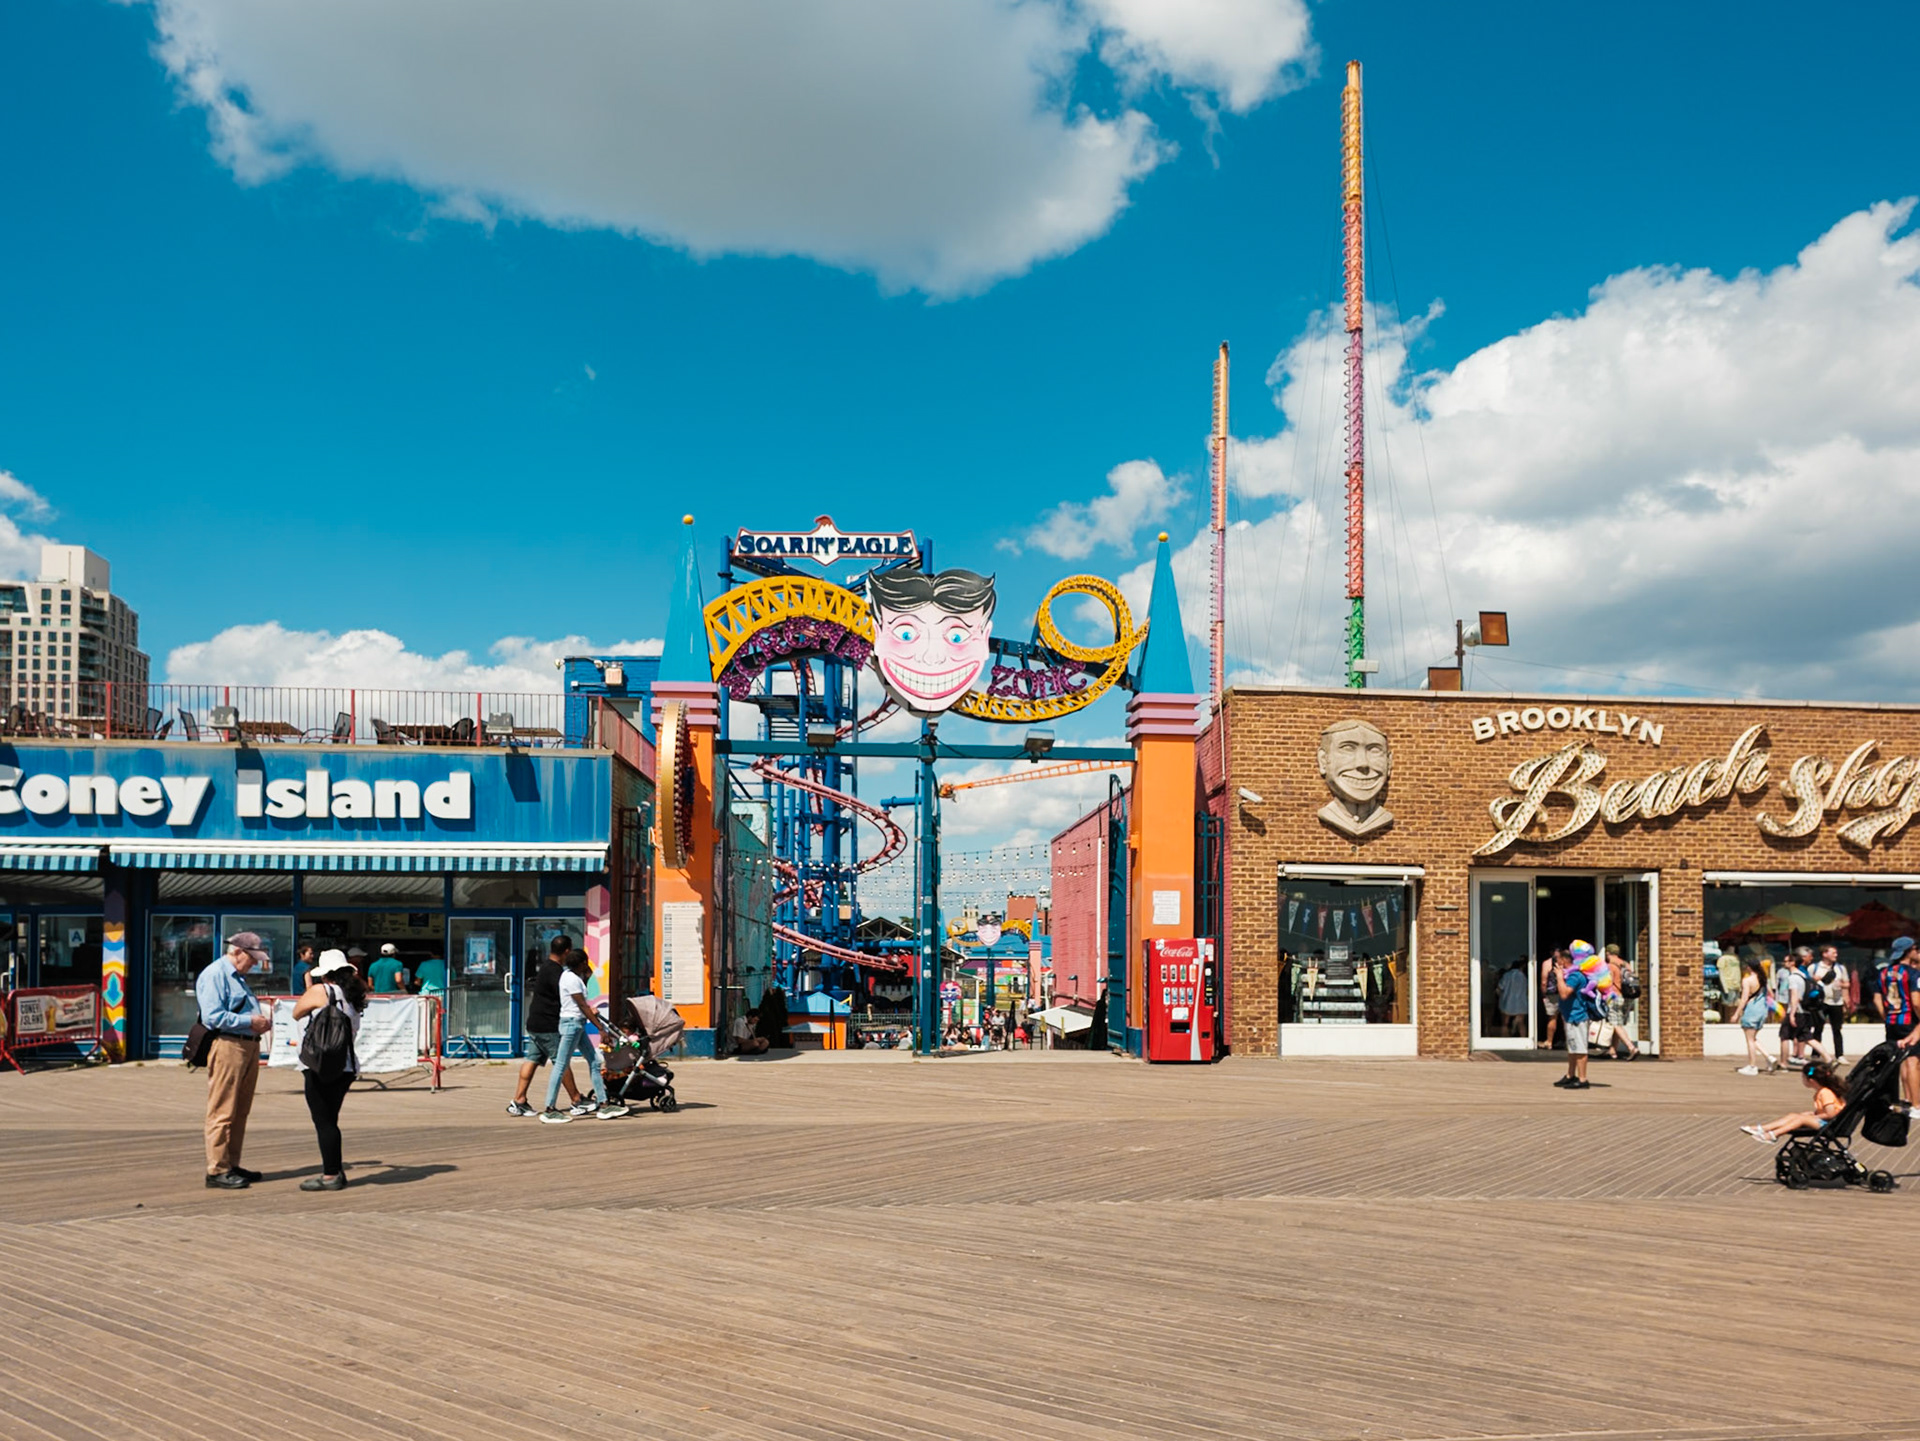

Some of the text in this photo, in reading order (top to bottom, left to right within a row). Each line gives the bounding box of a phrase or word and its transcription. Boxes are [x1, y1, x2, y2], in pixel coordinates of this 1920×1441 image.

[739, 535, 913, 556] SOARIN' EAGLE
[1472, 707, 1664, 746] BROOKLYN
[236, 769, 471, 820] island
[1472, 723, 1775, 857] Beach
[71, 930, 83, 942] A
[1160, 946, 1194, 958] Coca-Cola
